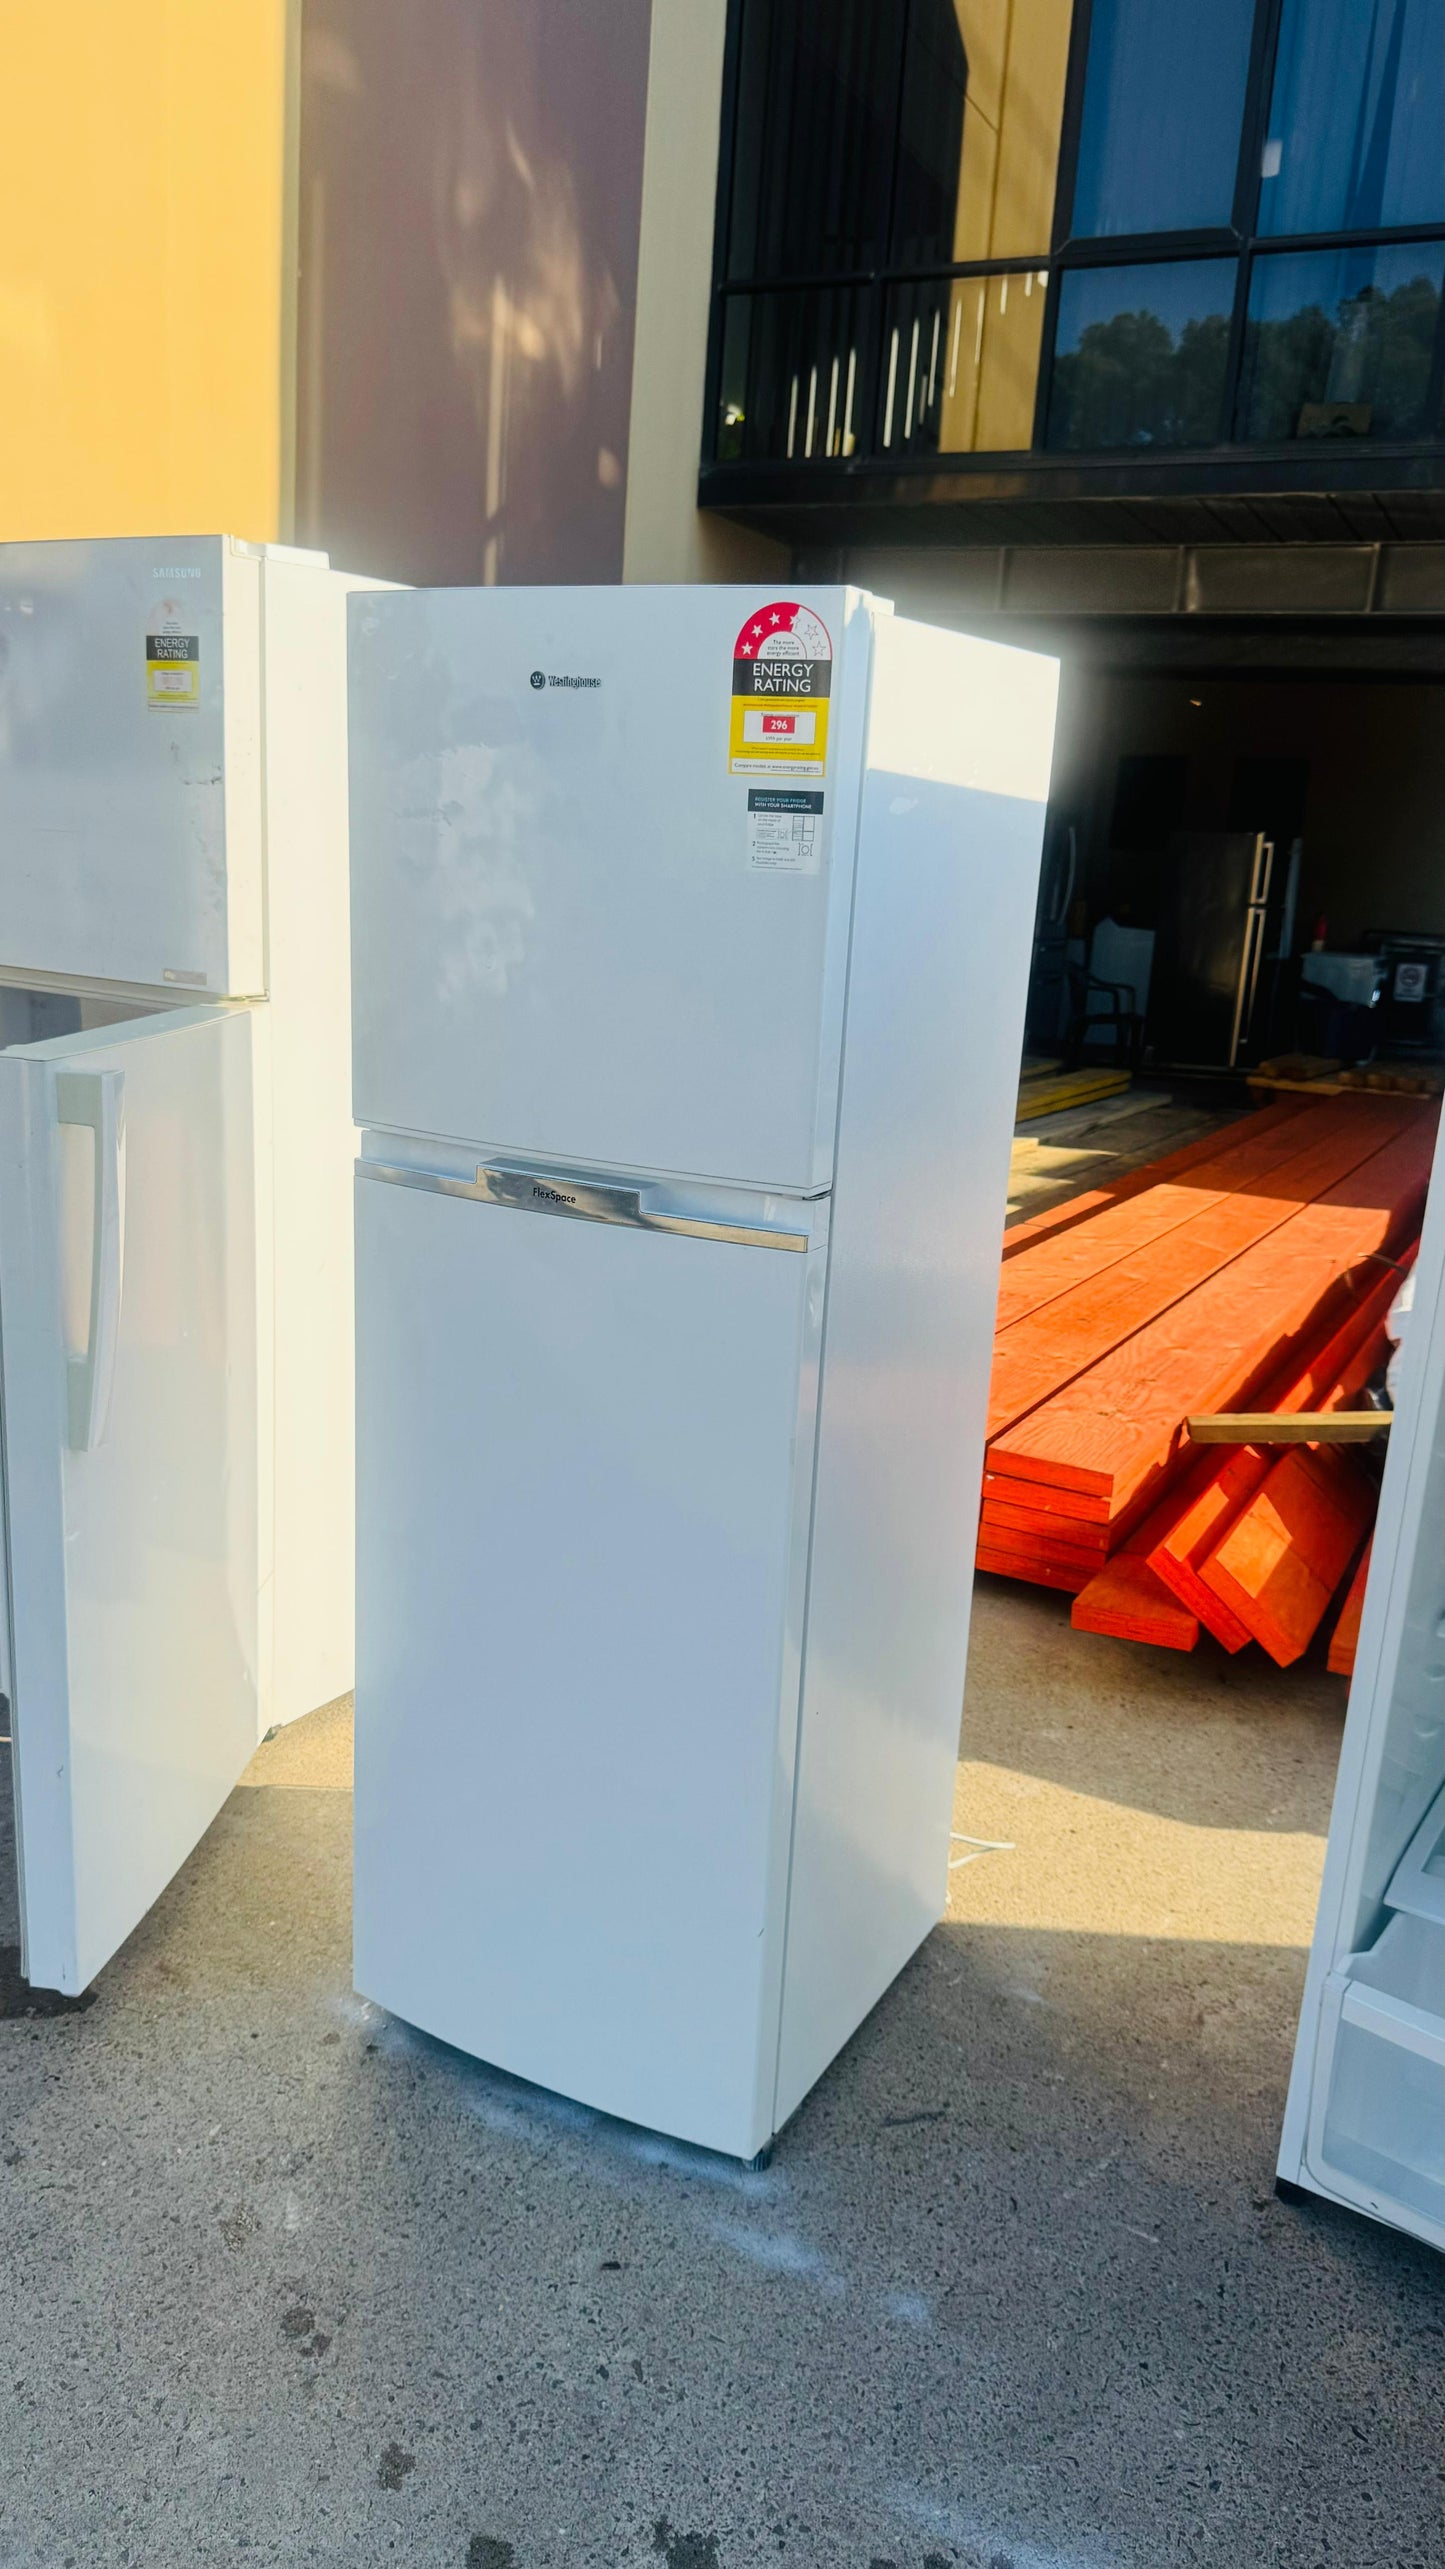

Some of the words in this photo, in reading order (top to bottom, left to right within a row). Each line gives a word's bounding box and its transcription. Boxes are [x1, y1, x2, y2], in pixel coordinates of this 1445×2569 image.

[153, 568, 200, 578] SAMSUNG
[154, 638, 190, 648] ENERGY
[157, 648, 188, 659] RATING
[753, 662, 814, 677] ENERGY
[548, 675, 601, 689] Westinghouse
[754, 678, 812, 693] RATING
[770, 719, 788, 730] 296
[533, 1187, 576, 1203] FlexSpace
